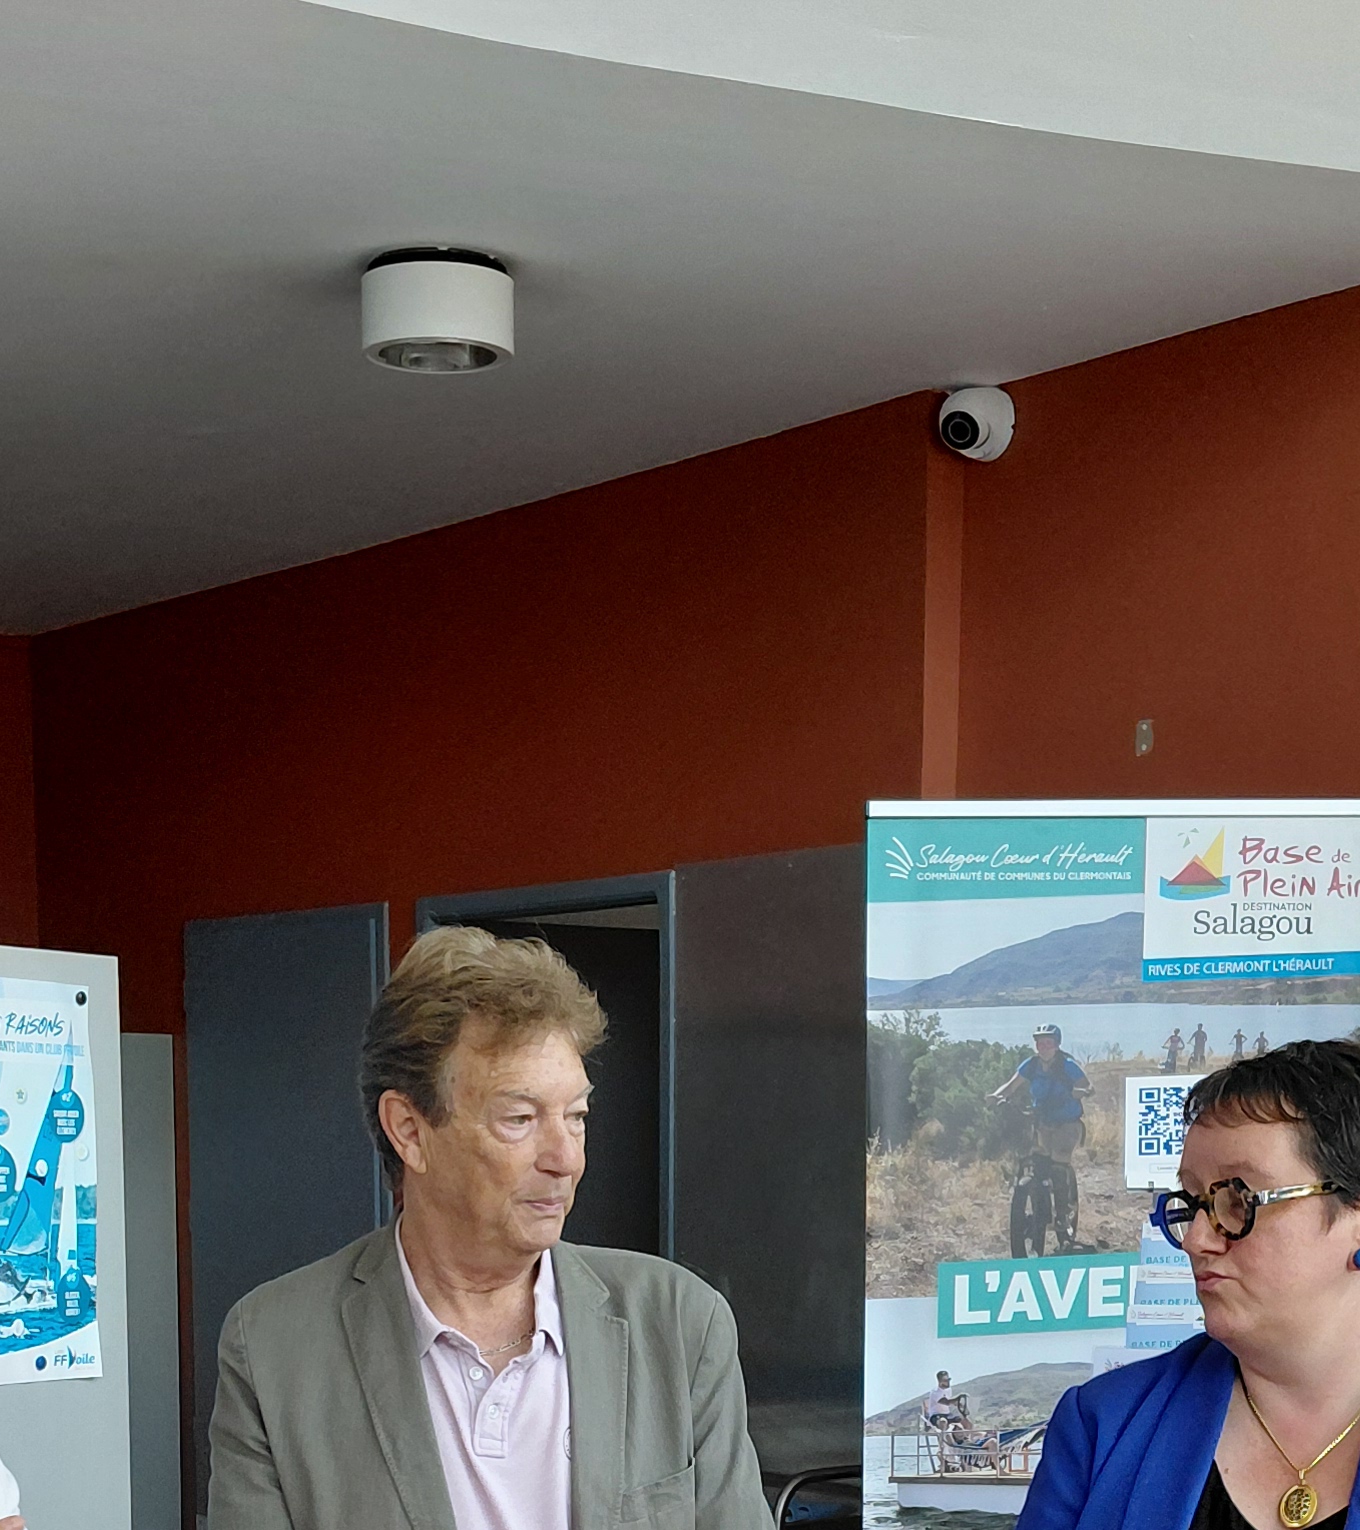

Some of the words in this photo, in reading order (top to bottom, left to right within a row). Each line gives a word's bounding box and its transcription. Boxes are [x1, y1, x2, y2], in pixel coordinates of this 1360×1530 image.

[916, 844, 989, 872] Salagou
[991, 843, 1040, 868] Cœur
[1042, 842, 1133, 870] d'Hérault
[1238, 835, 1324, 865] Base
[1331, 848, 1351, 863] de
[916, 870, 982, 881] COMMUNAUTÉ
[984, 872, 996, 881] DE
[998, 871, 1051, 881] COMMUNES
[1053, 872, 1065, 881] DU
[1068, 871, 1132, 881] CLERMONTAIS
[1242, 902, 1312, 911] DESTINATION
[1193, 903, 1314, 942] Salagou
[1148, 963, 1181, 976] RIVES
[1183, 962, 1200, 975] DE
[1202, 960, 1272, 974] CLERMONT
[1273, 958, 1335, 972] L'HÉRAULT
[1173, 1255, 1187, 1263] DE
